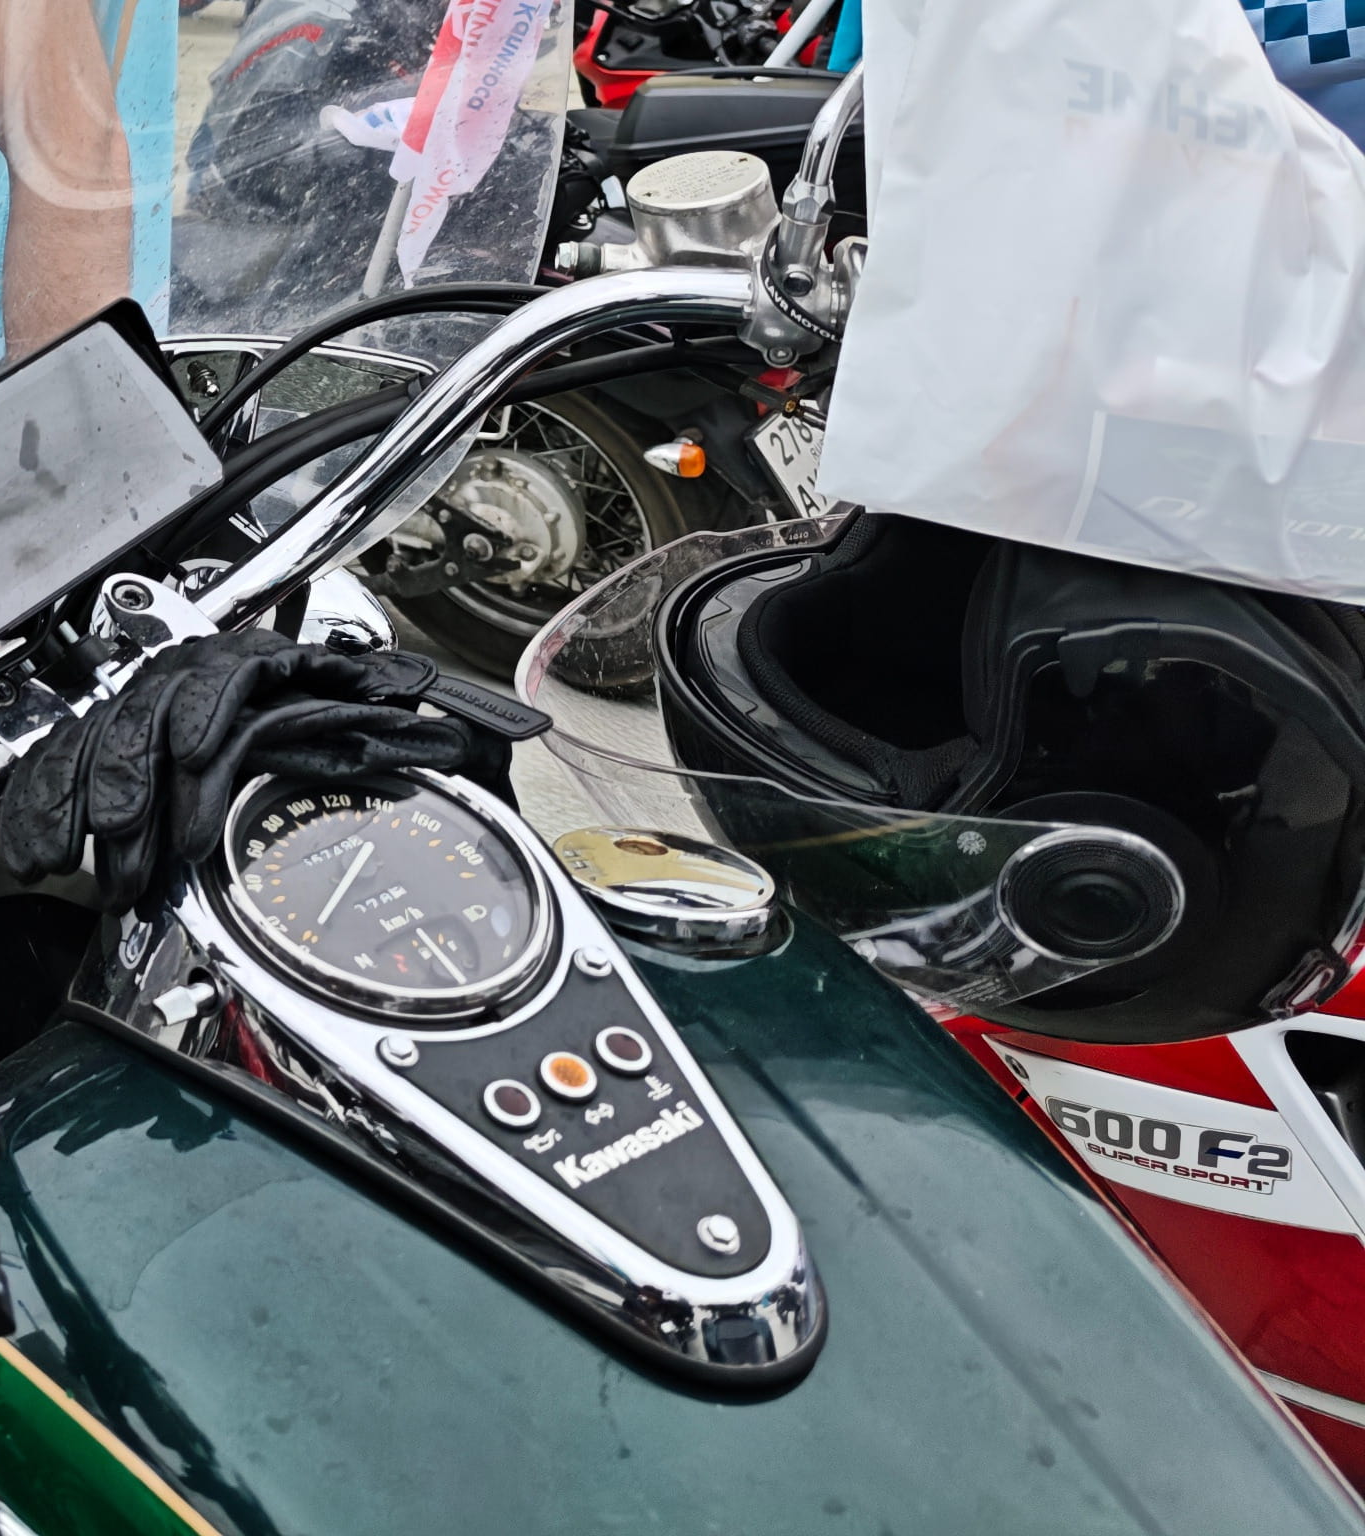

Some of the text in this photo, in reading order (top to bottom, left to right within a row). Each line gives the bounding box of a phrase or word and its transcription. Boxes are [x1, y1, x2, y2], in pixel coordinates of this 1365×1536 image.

[764, 276, 842, 343] LAVR MOTOL
[286, 799, 316, 818] 100
[321, 794, 352, 809] 120
[365, 796, 395, 813] 140
[262, 814, 285, 833] 80
[411, 811, 442, 833] 160
[246, 839, 266, 859] 60
[379, 907, 425, 933] km/h
[553, 1100, 704, 1190] Kawasaki
[1047, 1098, 1290, 1179] 600 F2
[1087, 1142, 1270, 1192] SUPER SPORT
